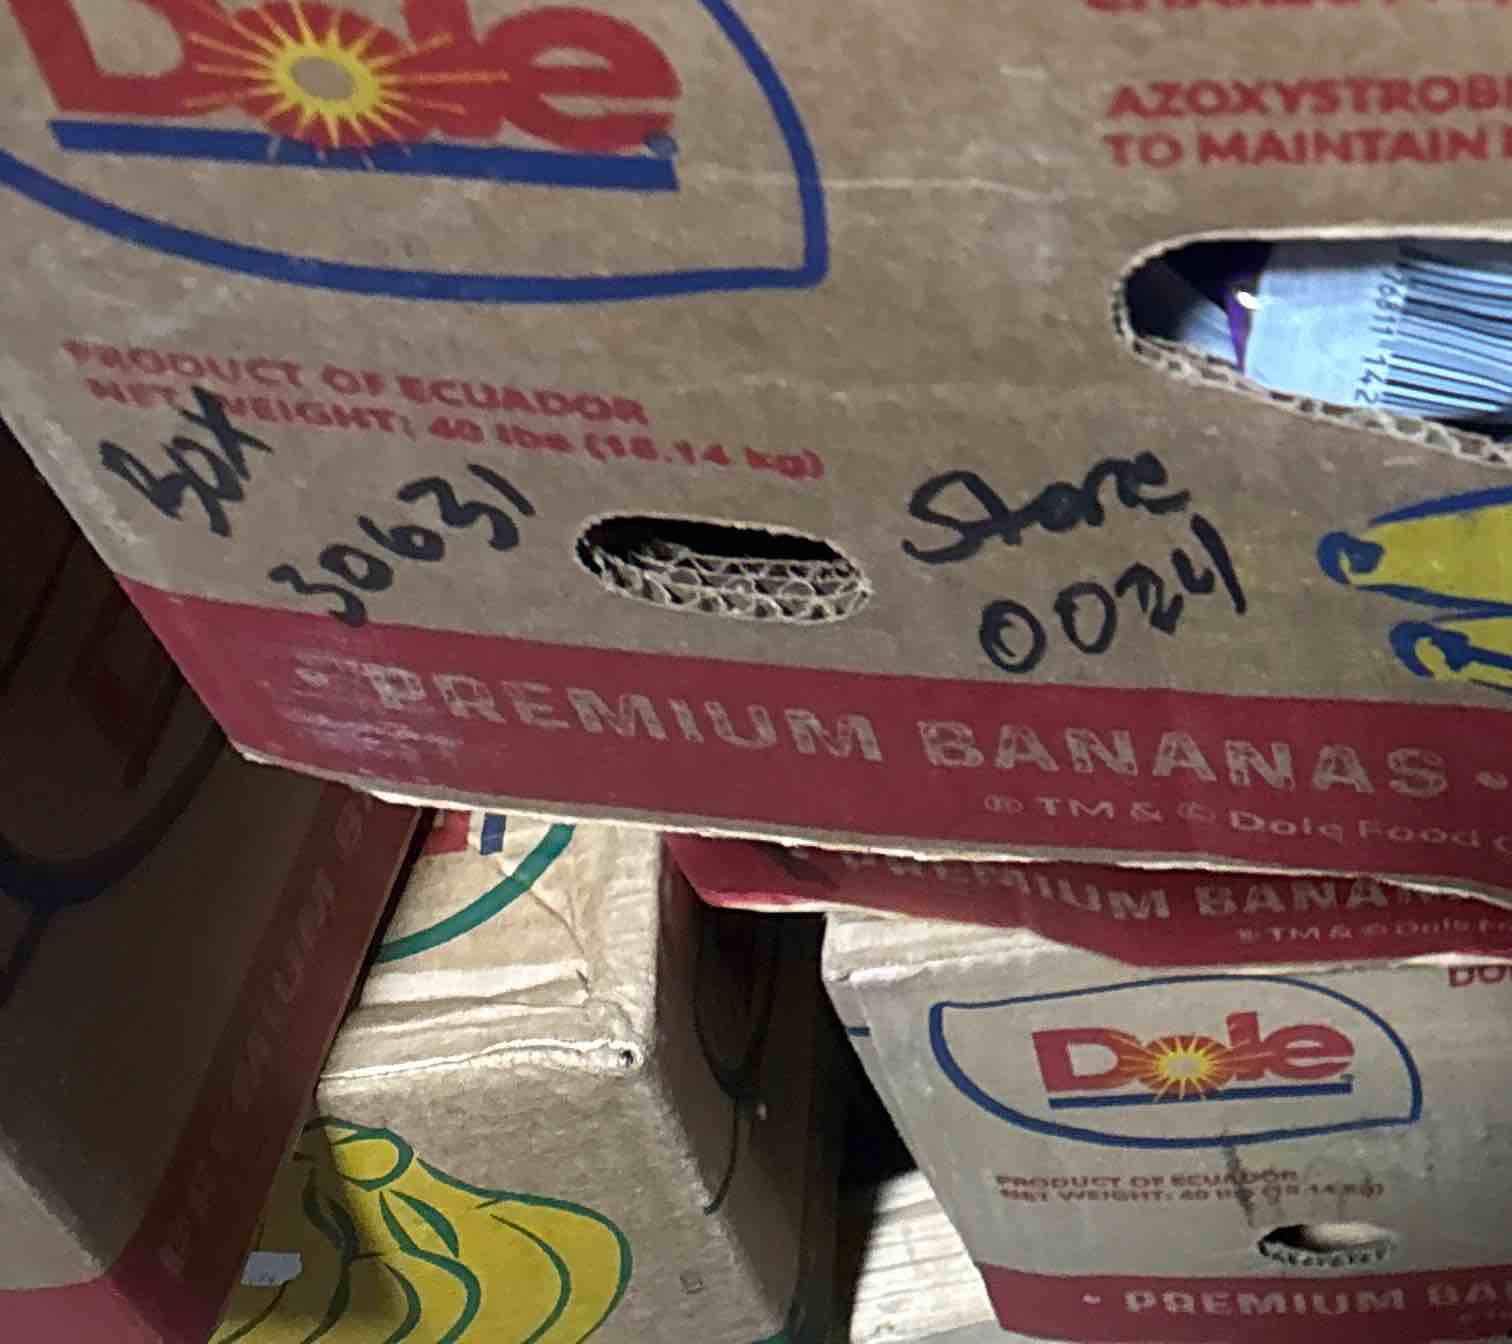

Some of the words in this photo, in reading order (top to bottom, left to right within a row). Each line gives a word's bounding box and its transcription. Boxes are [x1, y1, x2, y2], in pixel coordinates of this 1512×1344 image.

[1102, 132, 1185, 168] TO
[1198, 126, 1489, 168] MAINTAIN
[60, 338, 304, 393] PRODUCT
[321, 365, 387, 398] OF
[400, 375, 650, 427] ECUADOR
[364, 662, 885, 765] PREMIUM
[918, 718, 1449, 804] BANANAS
[1029, 1009, 1356, 1095] Dole
[1124, 1289, 1409, 1319] PREMIUM
